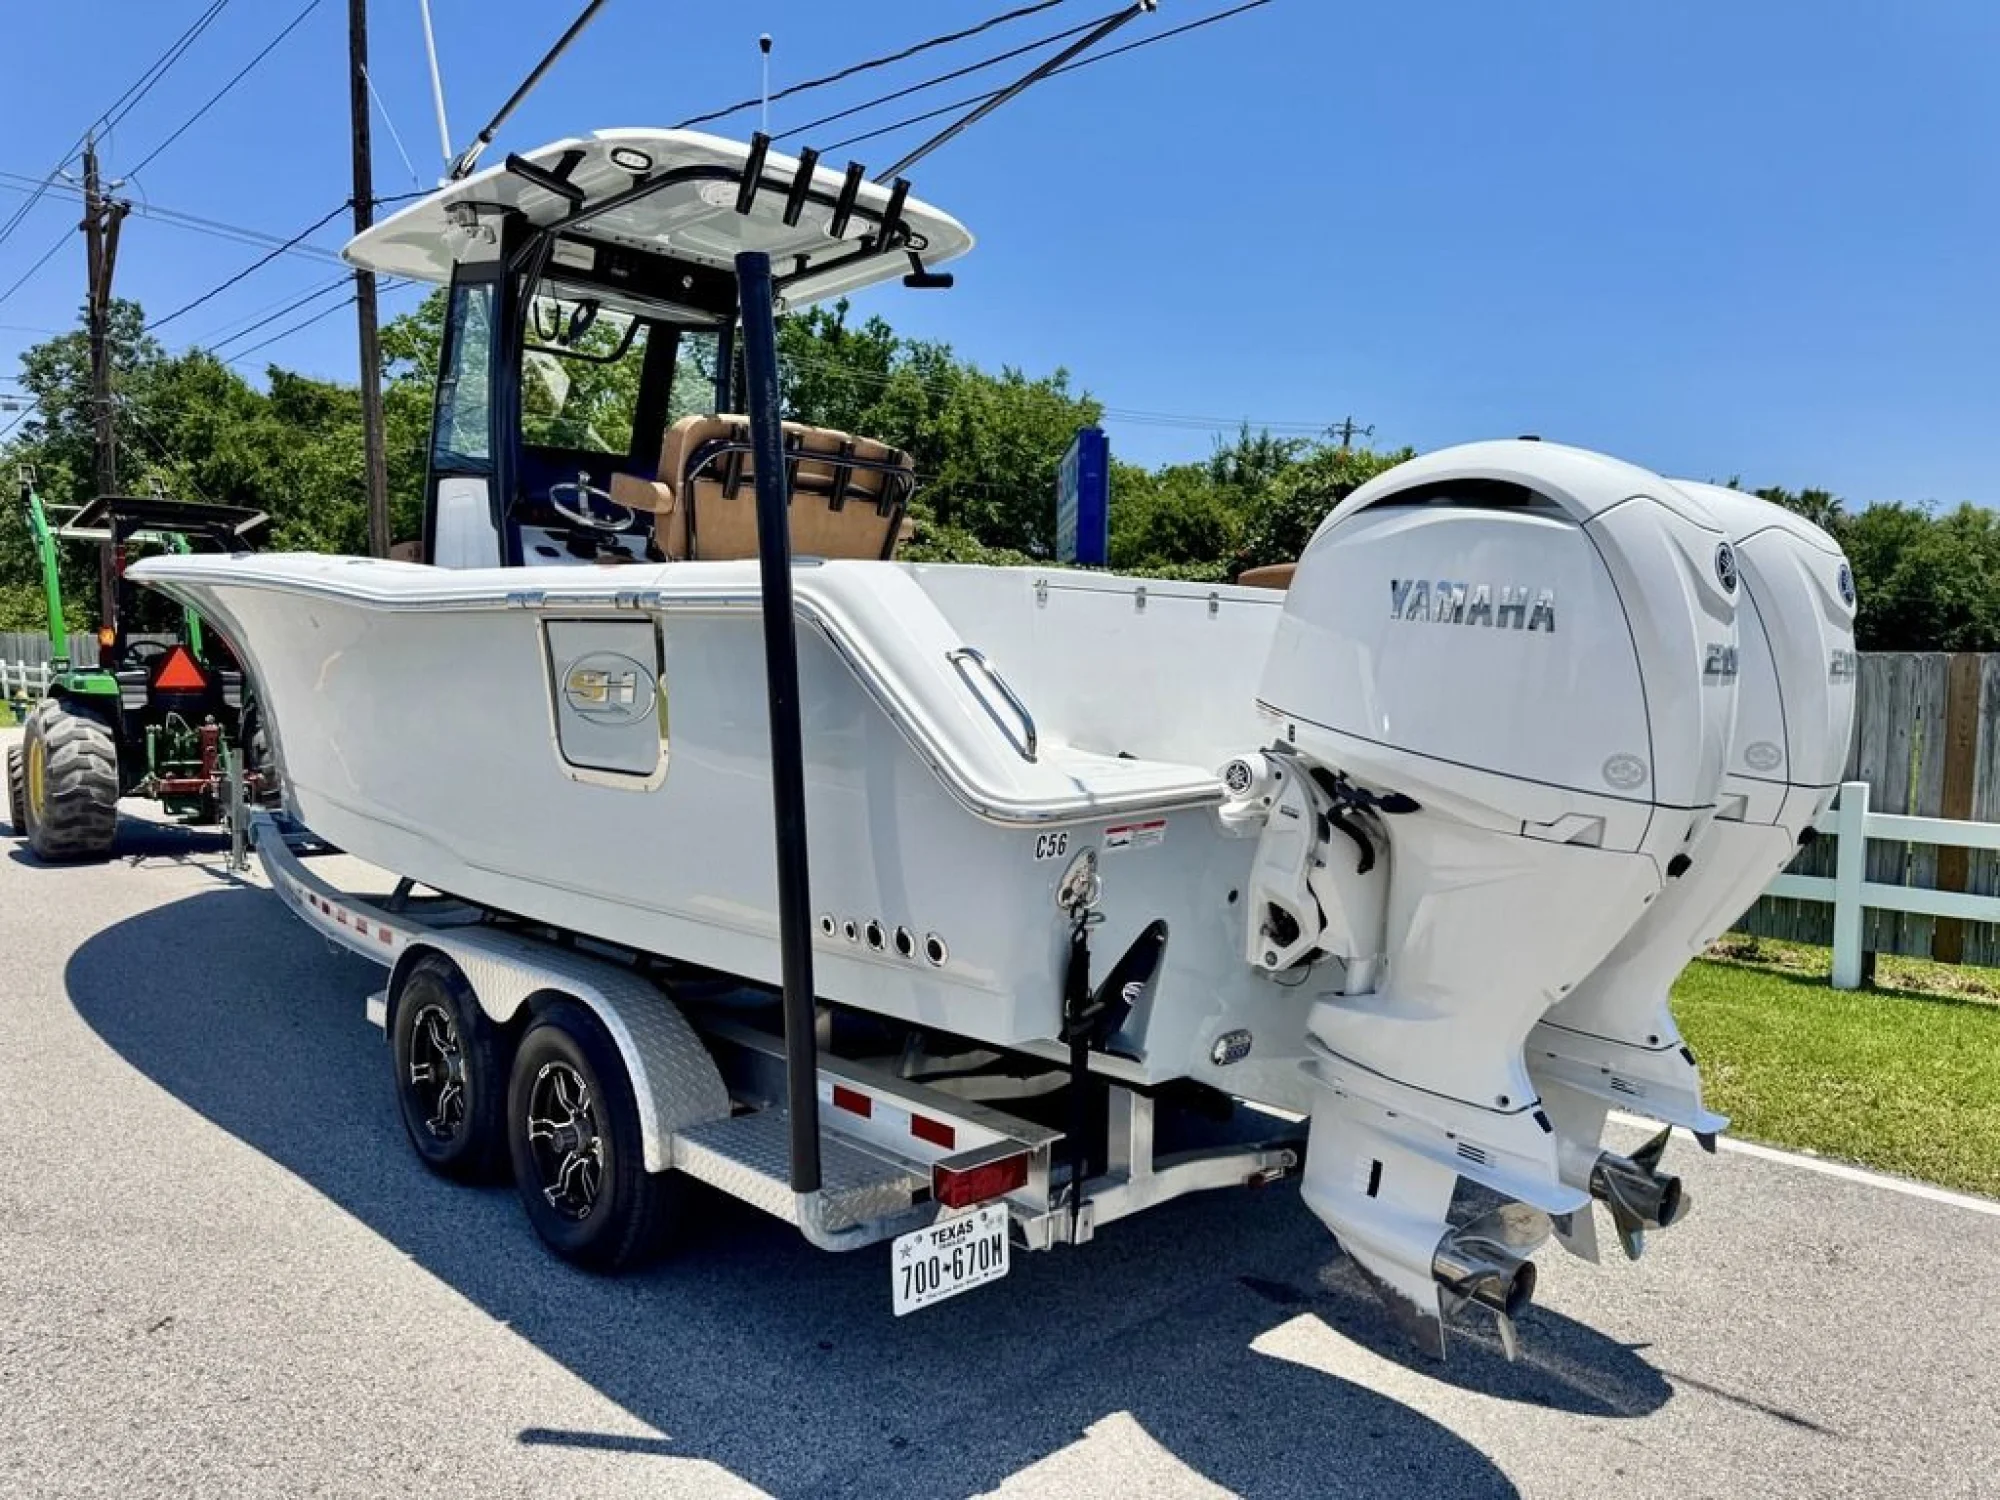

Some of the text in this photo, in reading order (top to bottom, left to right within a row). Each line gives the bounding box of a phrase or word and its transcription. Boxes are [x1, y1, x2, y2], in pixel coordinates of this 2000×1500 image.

[1390, 579, 1556, 633] YAMAHA
[1036, 833, 1068, 860] C56
[929, 1220, 974, 1245] TEXAS
